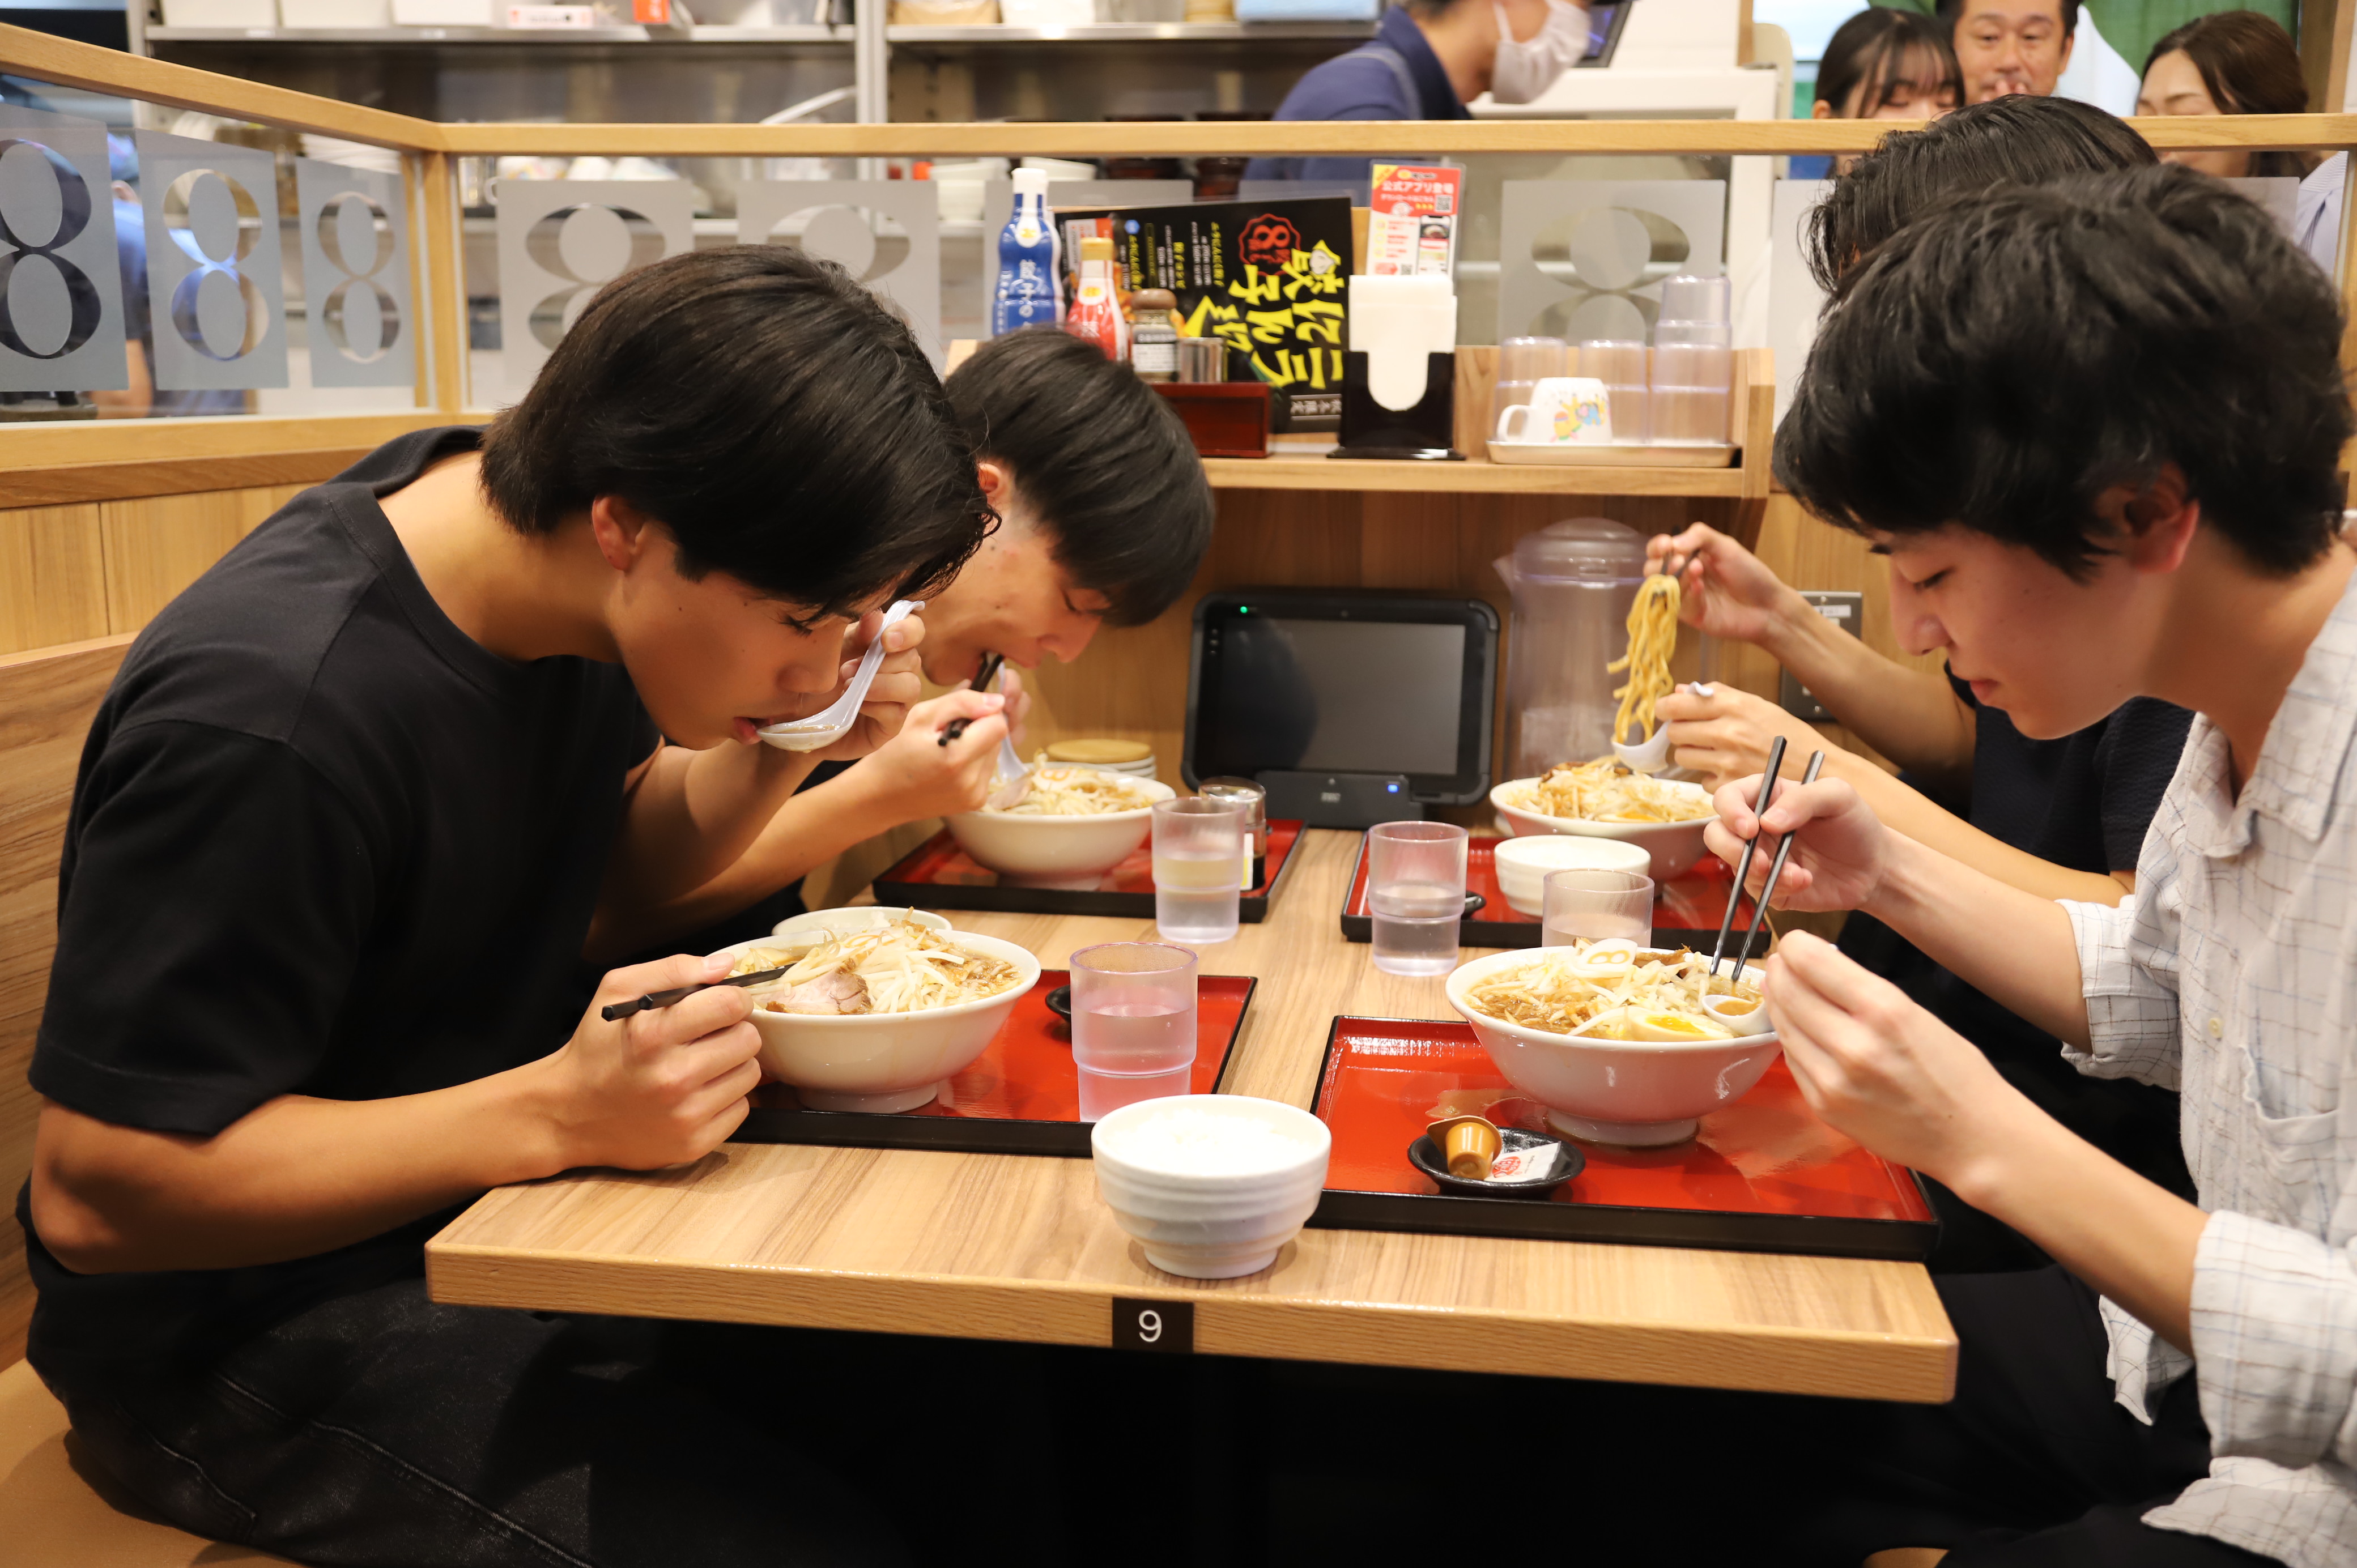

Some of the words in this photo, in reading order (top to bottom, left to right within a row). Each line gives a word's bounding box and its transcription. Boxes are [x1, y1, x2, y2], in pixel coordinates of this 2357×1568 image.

[0, 138, 102, 359] 8
[163, 168, 270, 362] 8
[1381, 180, 1454, 194] 公式アプリ登場
[317, 191, 400, 364] 8
[1138, 1309, 1162, 1343] 9
